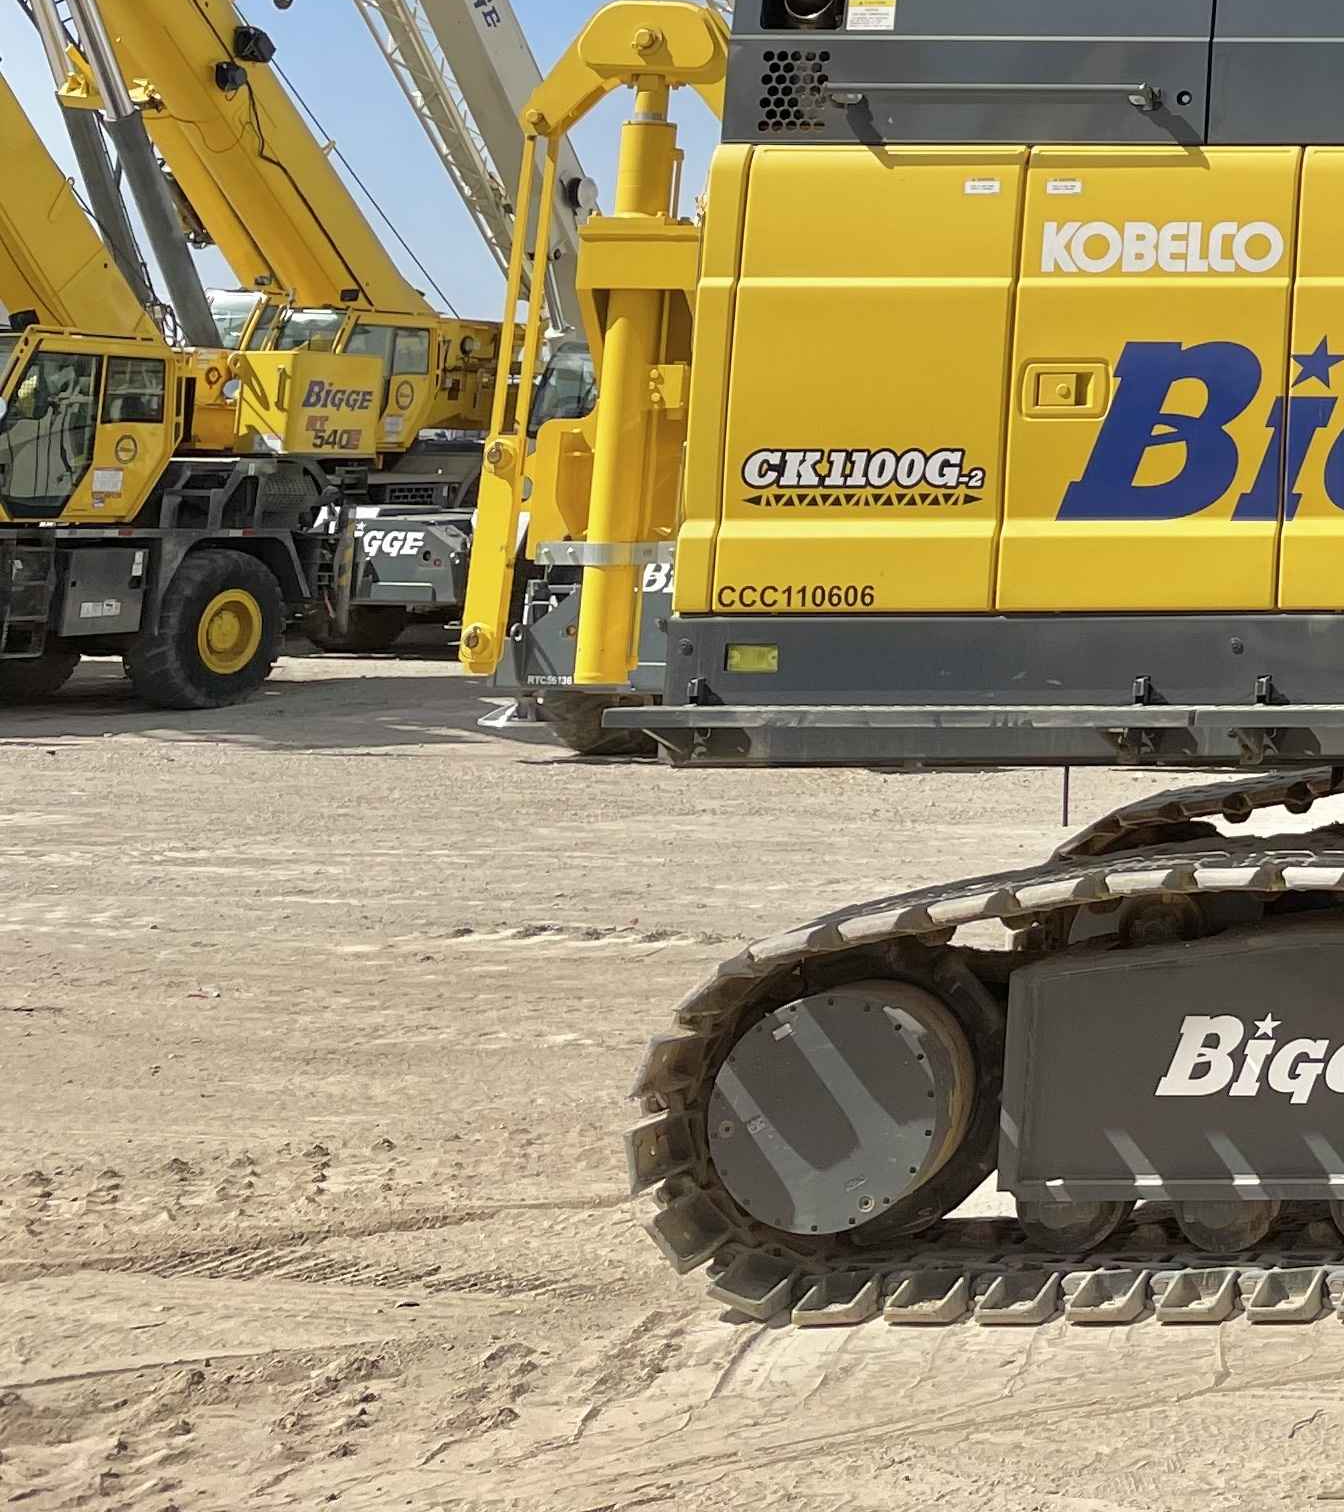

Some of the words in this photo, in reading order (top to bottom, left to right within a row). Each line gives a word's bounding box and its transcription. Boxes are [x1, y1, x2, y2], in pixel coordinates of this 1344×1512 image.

[1041, 221, 1284, 273] KOBELCO
[302, 380, 373, 411] BIGGE
[717, 585, 876, 609] CCC110606
